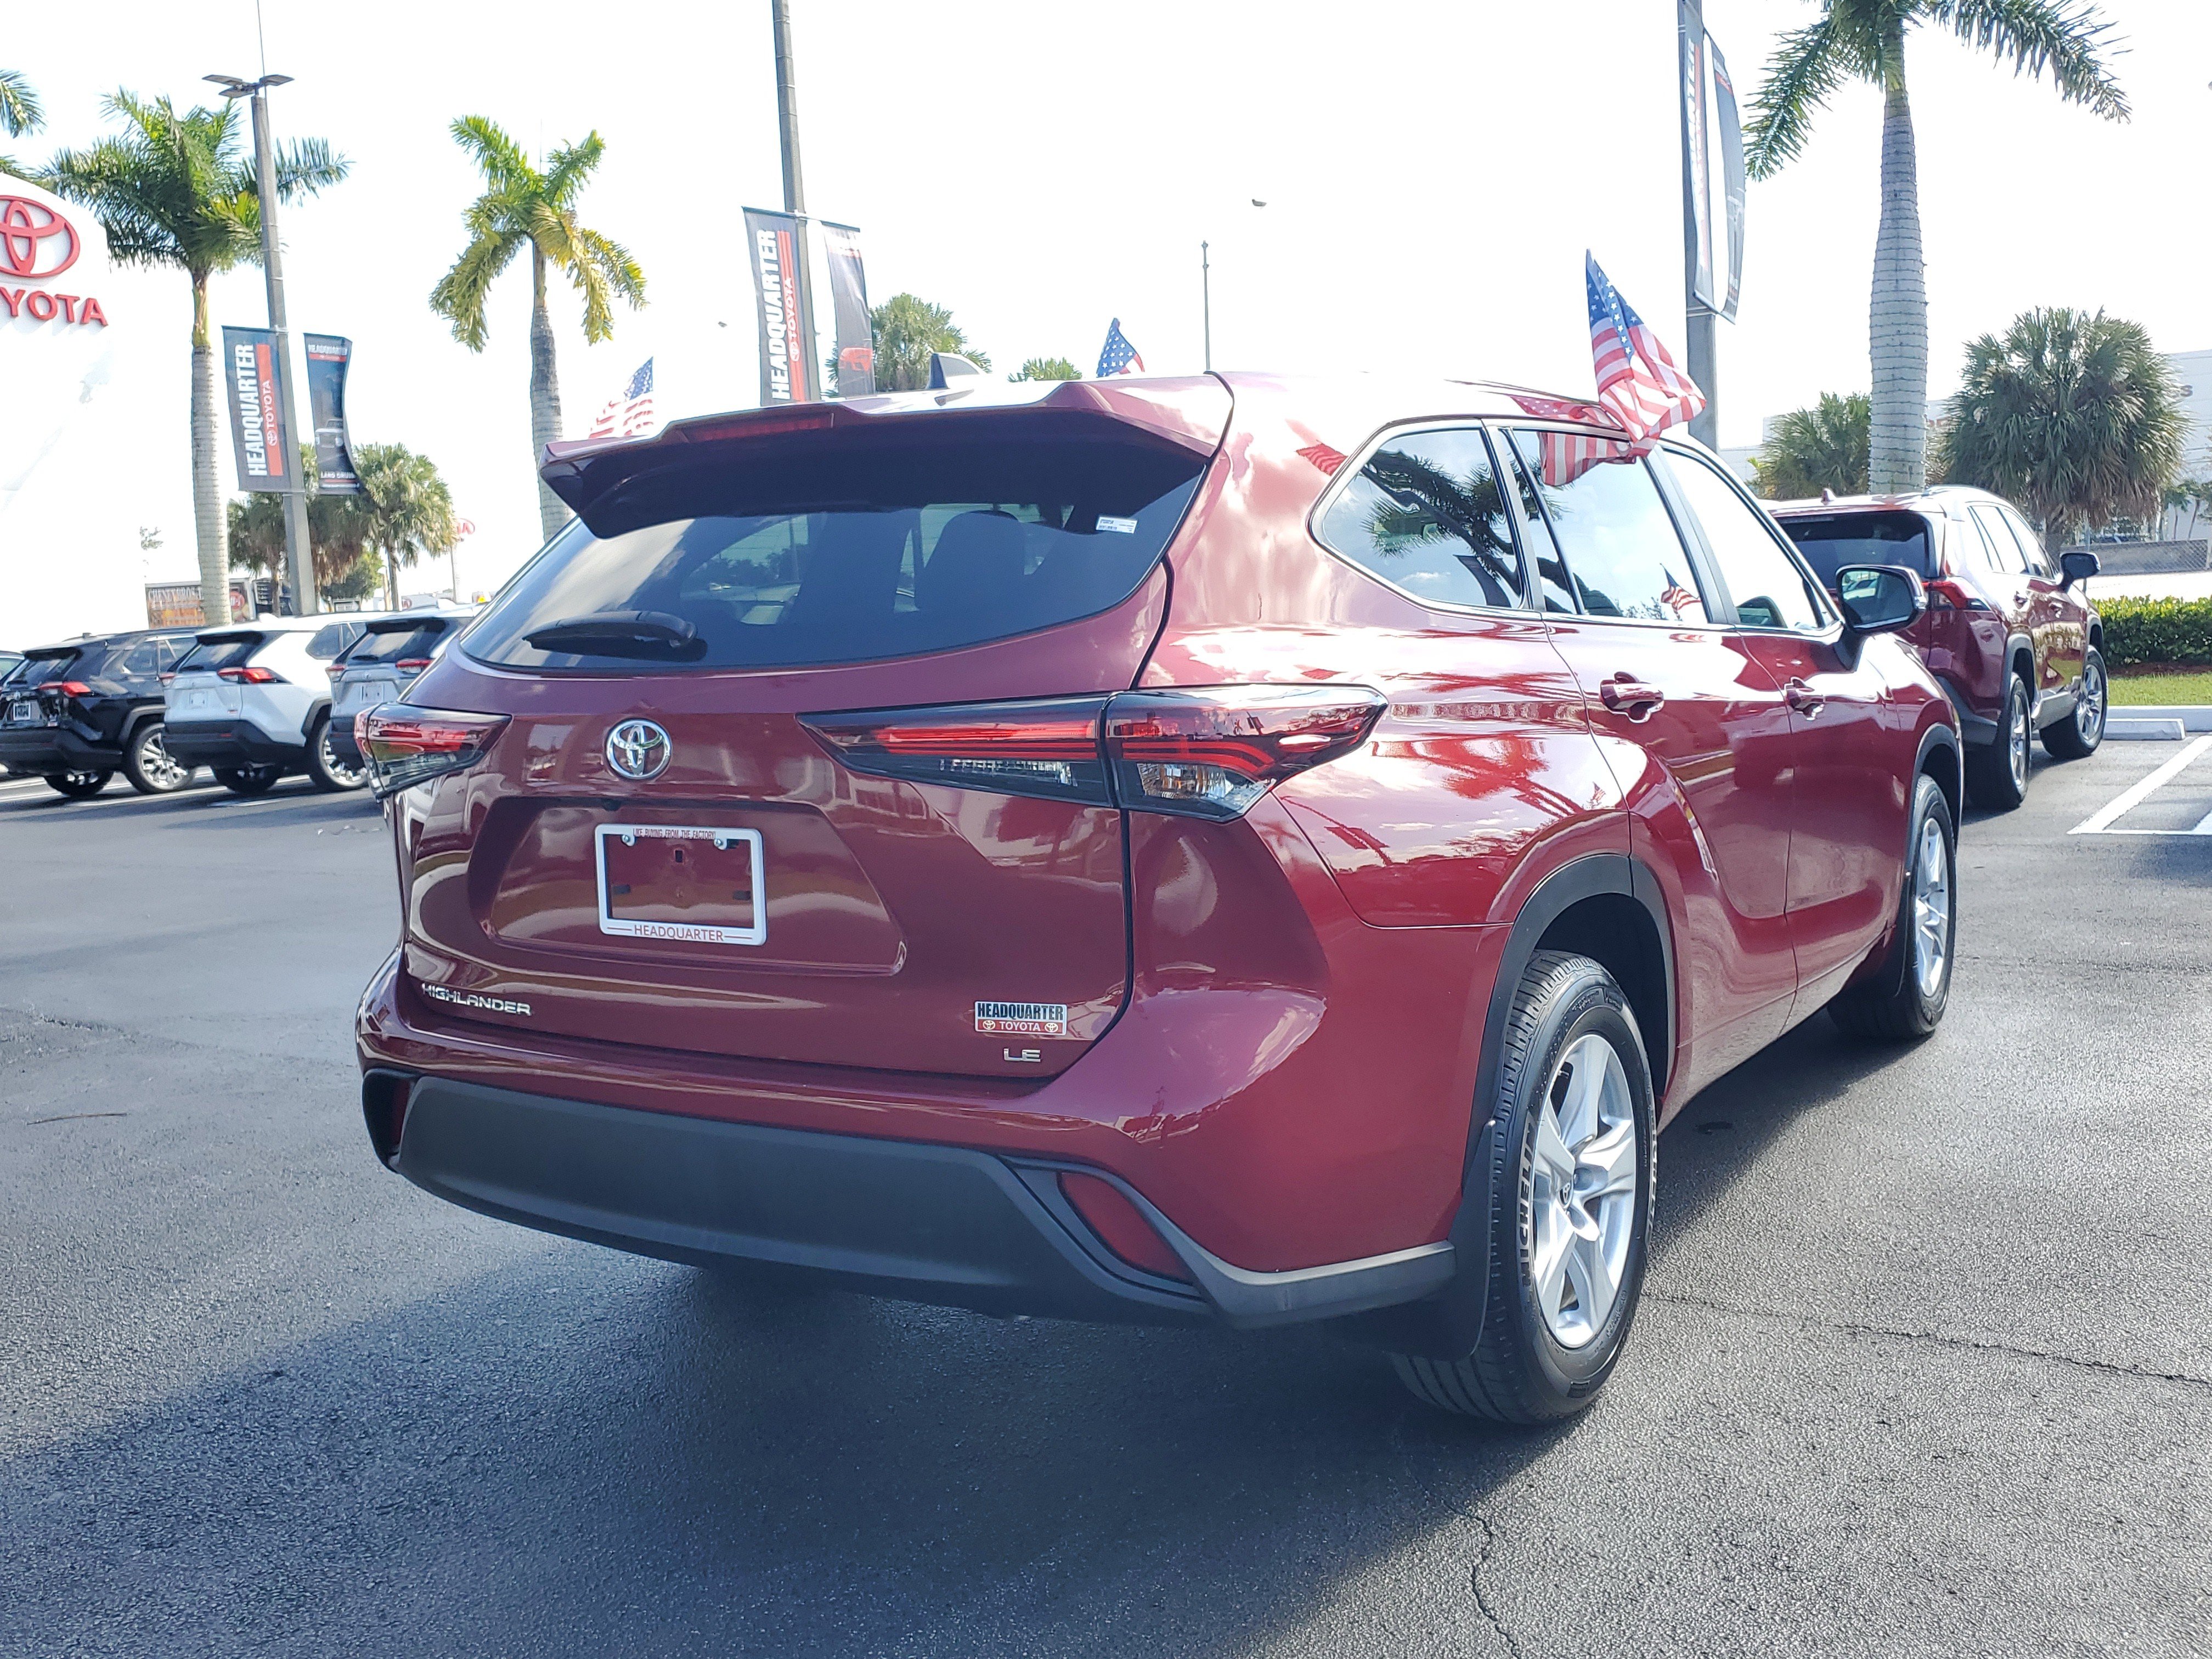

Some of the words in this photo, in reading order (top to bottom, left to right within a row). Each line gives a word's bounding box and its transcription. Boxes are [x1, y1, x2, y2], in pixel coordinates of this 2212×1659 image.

[0, 287, 109, 326] YOTA
[756, 229, 791, 400] HEADQUARTER
[784, 278, 798, 340] TOYOTA
[234, 343, 268, 476] HEADQUARTER
[262, 380, 275, 429] TOYOTA
[645, 828, 663, 838] BUYING
[665, 829, 679, 839] FROM
[681, 830, 691, 839] THE
[634, 924, 724, 941] HEADQUARTER
[421, 983, 532, 1016] HIGHLANDER
[977, 1002, 1064, 1021] HEADQUARTER
[999, 1021, 1041, 1031] TOYOTA
[1003, 1048, 1041, 1063] LE
[1520, 1121, 1536, 1288] MICHELIN
